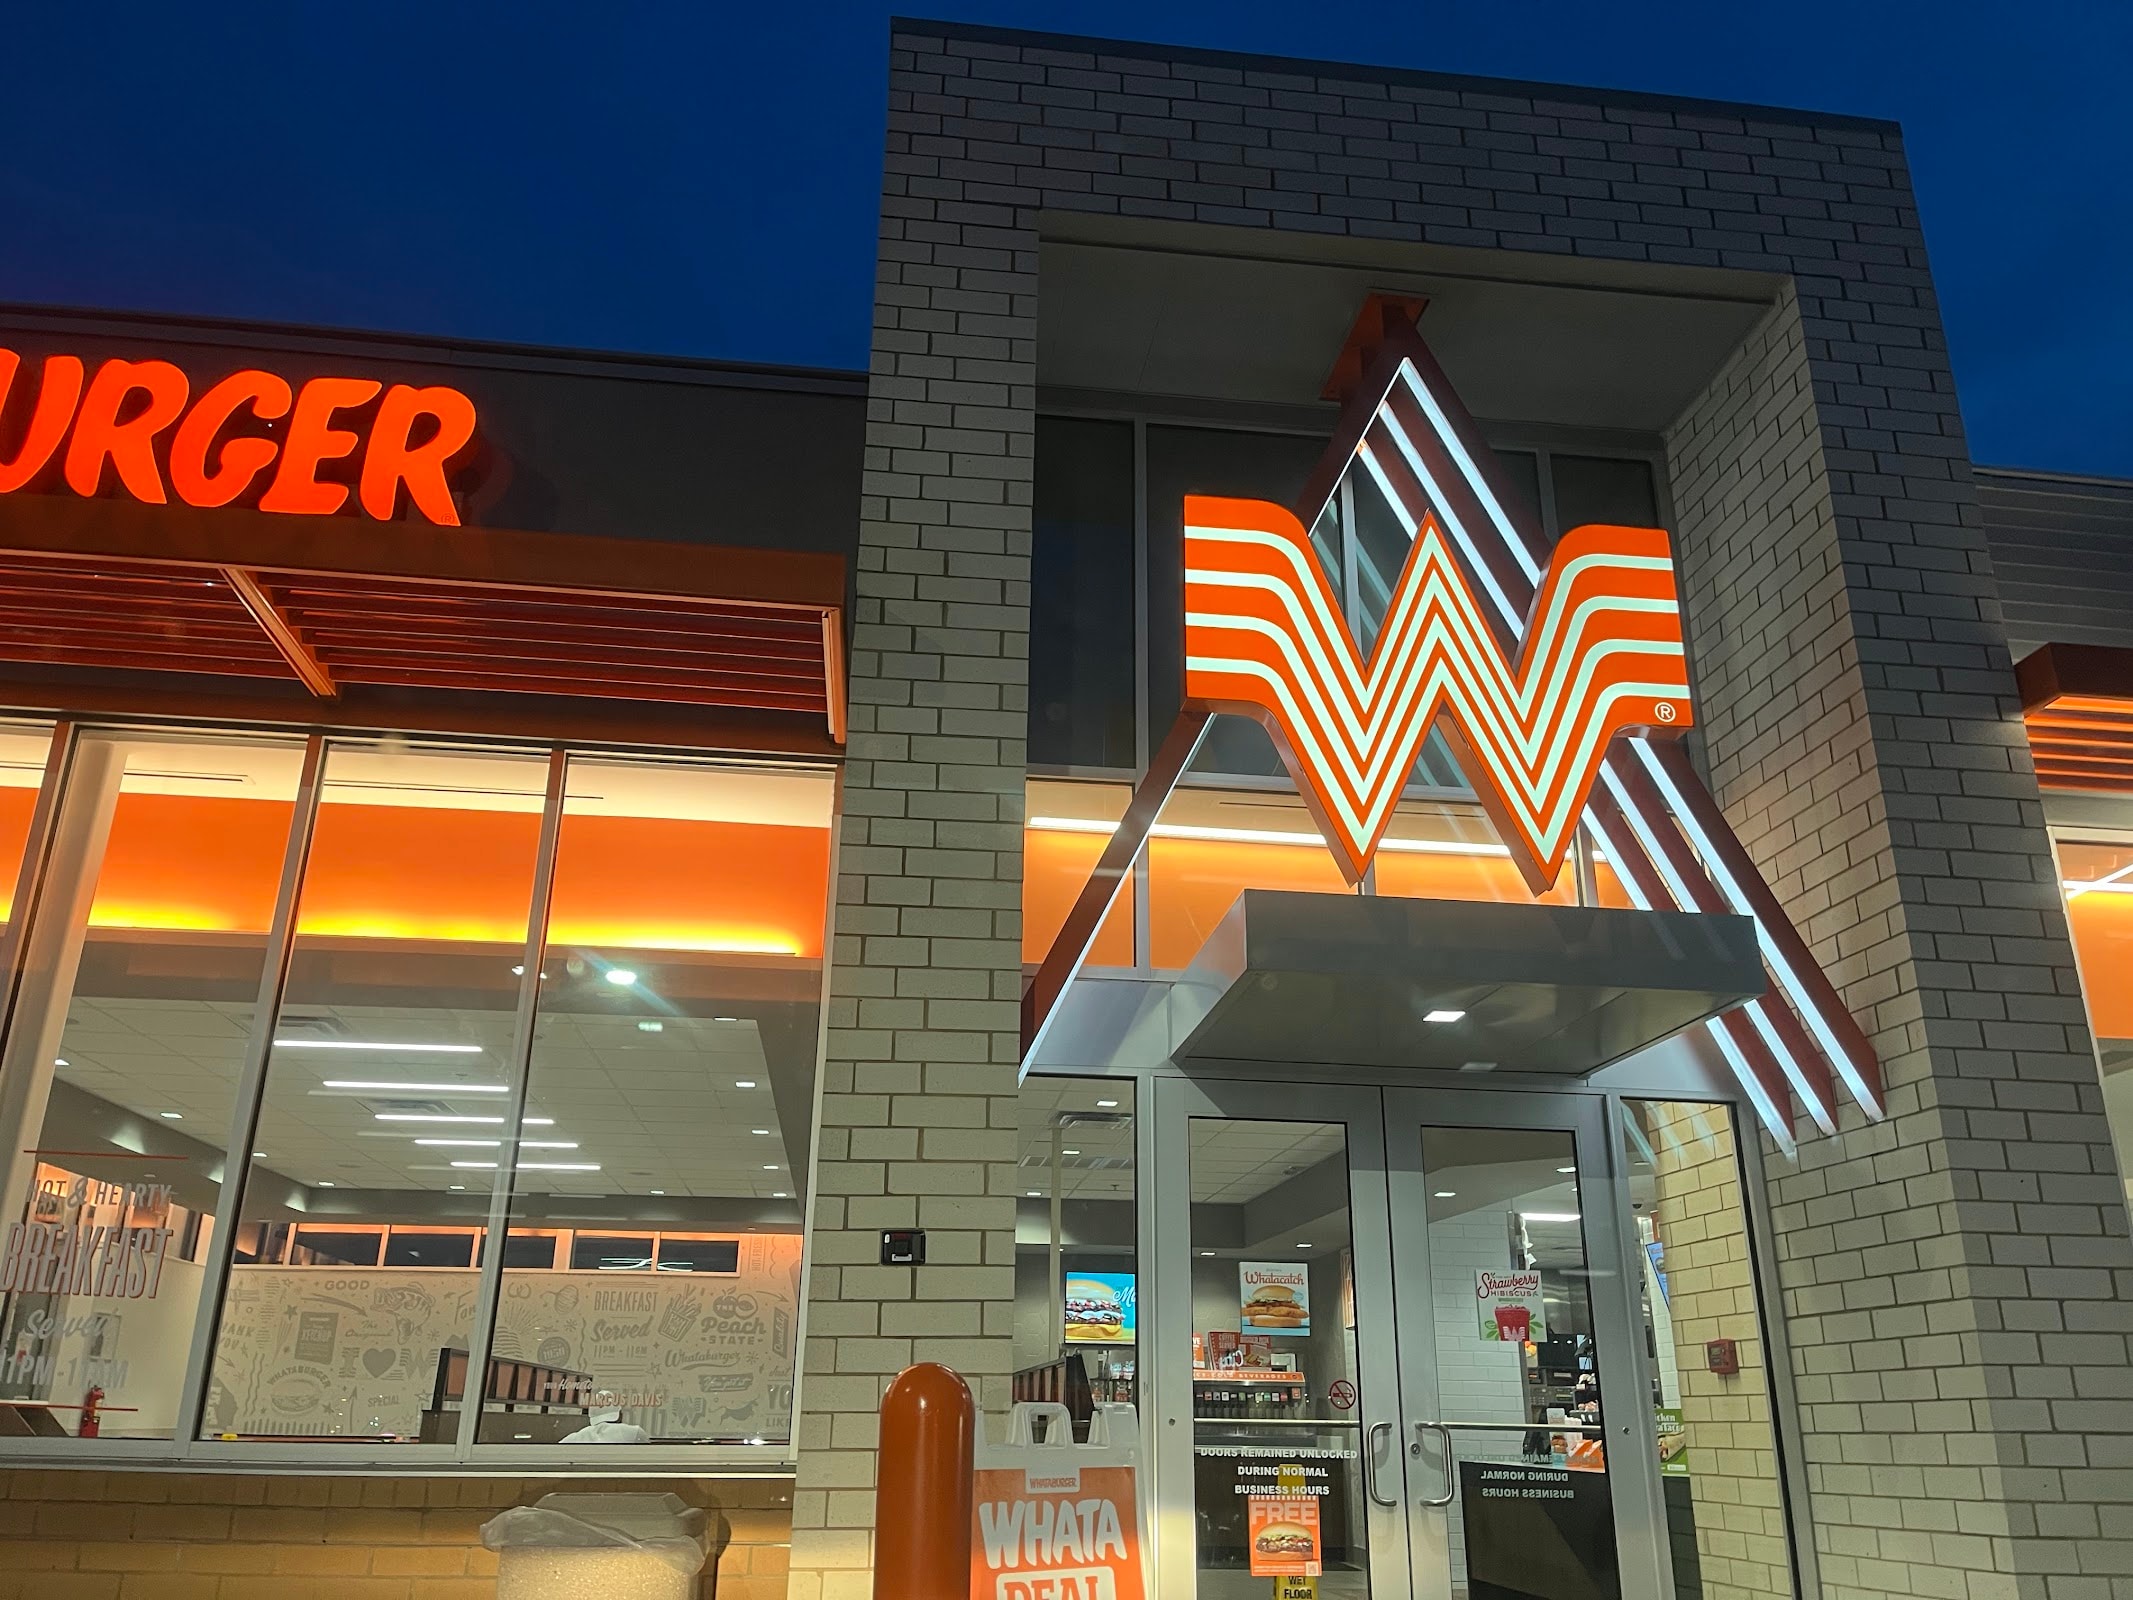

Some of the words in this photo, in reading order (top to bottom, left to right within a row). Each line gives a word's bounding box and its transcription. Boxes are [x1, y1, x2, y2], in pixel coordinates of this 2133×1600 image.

[95, 1182, 173, 1209] HEARTY
[0, 1222, 174, 1299] BREAKFAST
[324, 1280, 370, 1290] GOOD
[1243, 1271, 1305, 1286] Whatacatch
[1477, 1272, 1539, 1299] Strawberry
[594, 1290, 659, 1312] BREAKFAST
[590, 1315, 655, 1343] Served
[701, 1316, 767, 1335] Peach
[708, 1335, 756, 1346] STATE
[664, 1349, 741, 1369] Whataburger
[266, 1365, 332, 1389] WHATABURGER
[578, 1392, 628, 1408] MARCUS
[630, 1392, 664, 1408] DAVIS
[1200, 1448, 1239, 1457] DOORS
[1240, 1449, 1297, 1458] REMAINED
[1299, 1449, 1358, 1459] UNLOCKED
[1237, 1465, 1279, 1476] DURING
[1282, 1467, 1329, 1477] NORMAL
[1029, 1477, 1077, 1489] WHATABURGER
[1234, 1484, 1289, 1495] BUSINESS
[1291, 1485, 1330, 1495] HOURS
[1251, 1501, 1318, 1525] FREE
[978, 1498, 1128, 1570] WHATA
[1283, 1588, 1313, 1600] FLOOR
